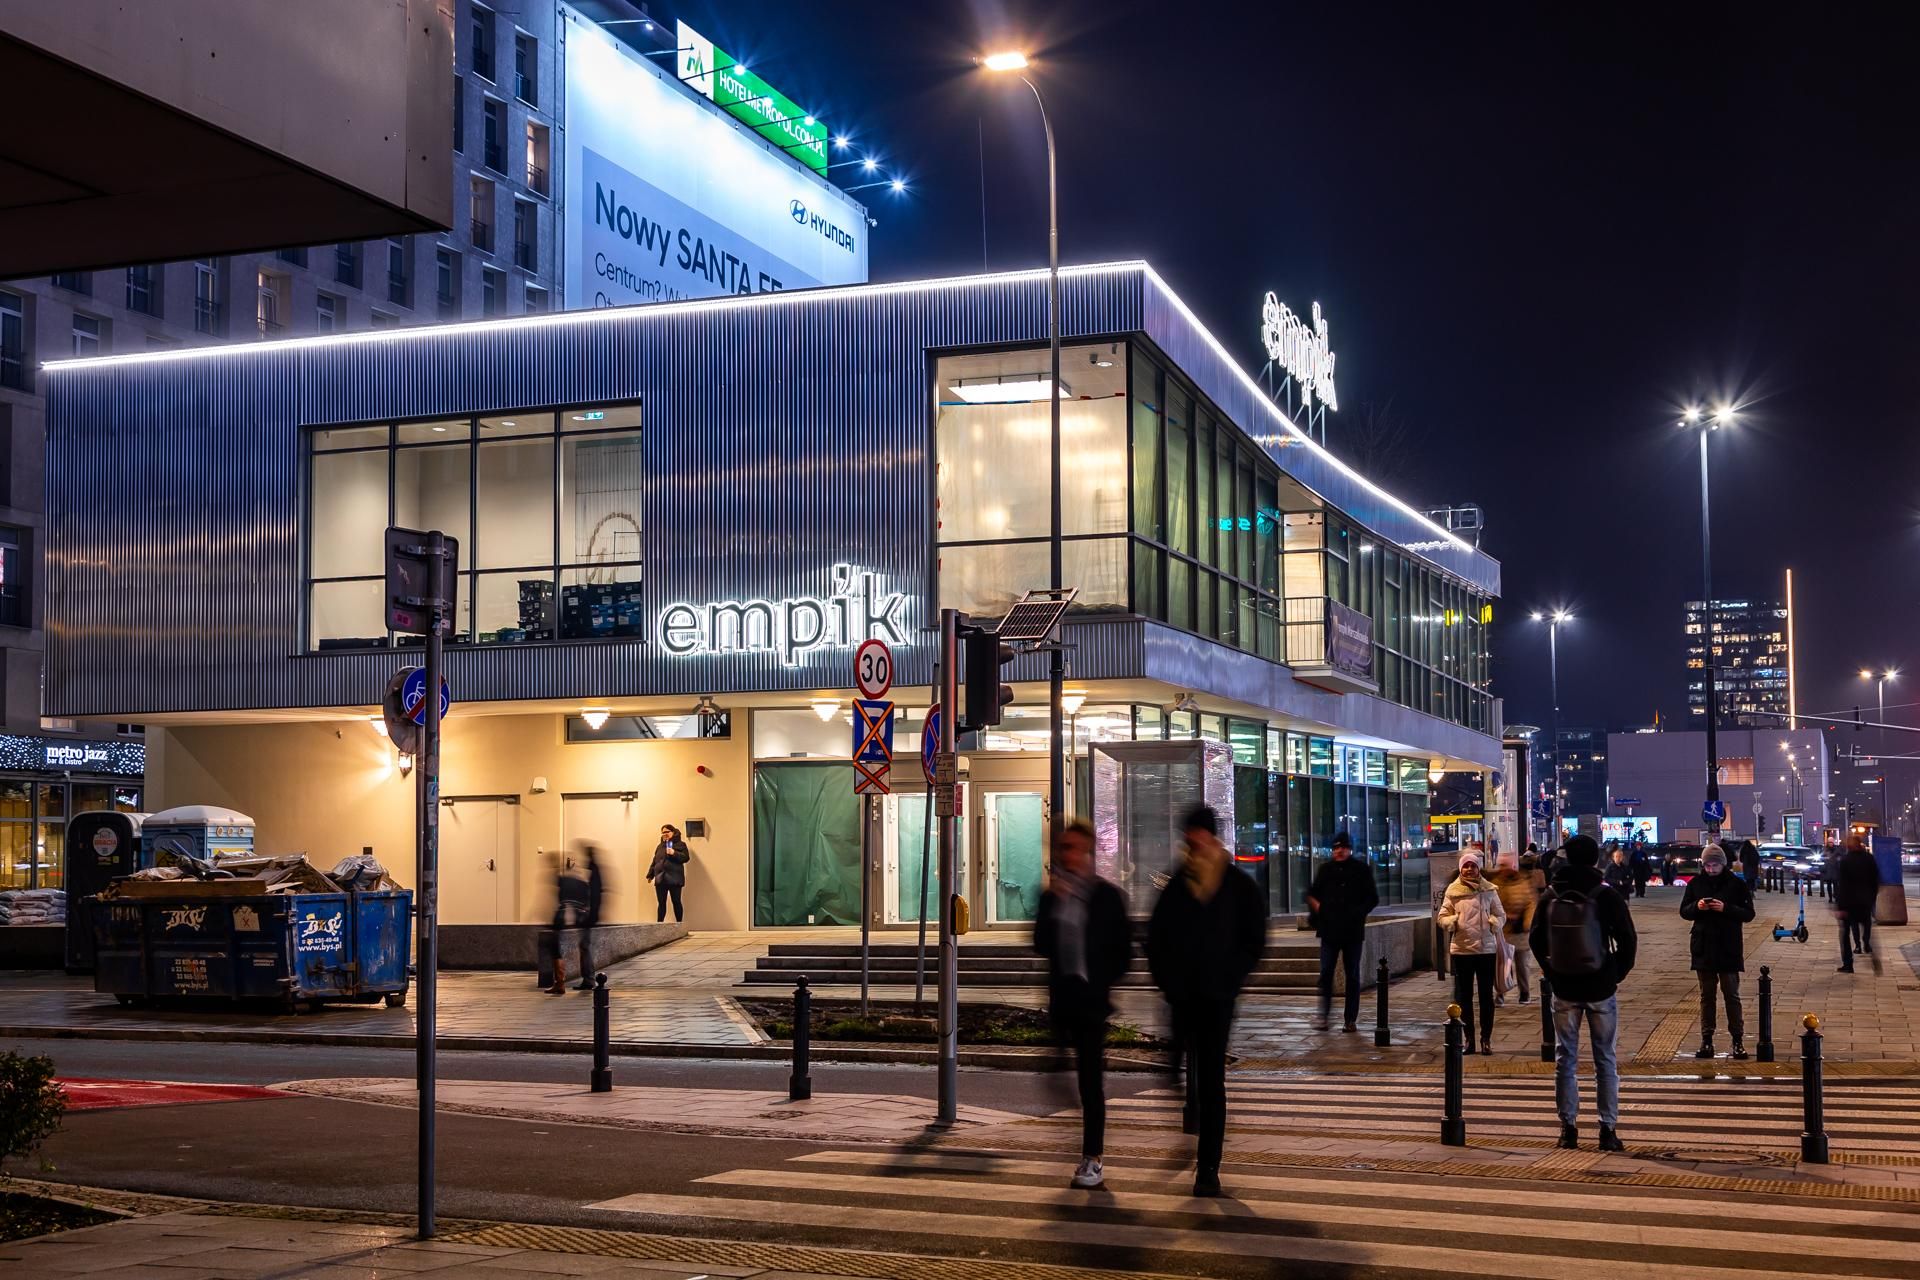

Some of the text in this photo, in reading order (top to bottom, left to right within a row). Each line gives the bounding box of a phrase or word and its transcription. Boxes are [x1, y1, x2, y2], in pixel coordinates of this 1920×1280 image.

[595, 181, 671, 267] Nowy
[677, 228, 752, 295] SANTA
[810, 211, 854, 253] HYUNDAI
[595, 252, 661, 303] Centrum?
[658, 564, 908, 667] empik
[861, 654, 887, 684] 30
[46, 745, 108, 762] metro jazz
[299, 941, 342, 952] www.bys.pl
